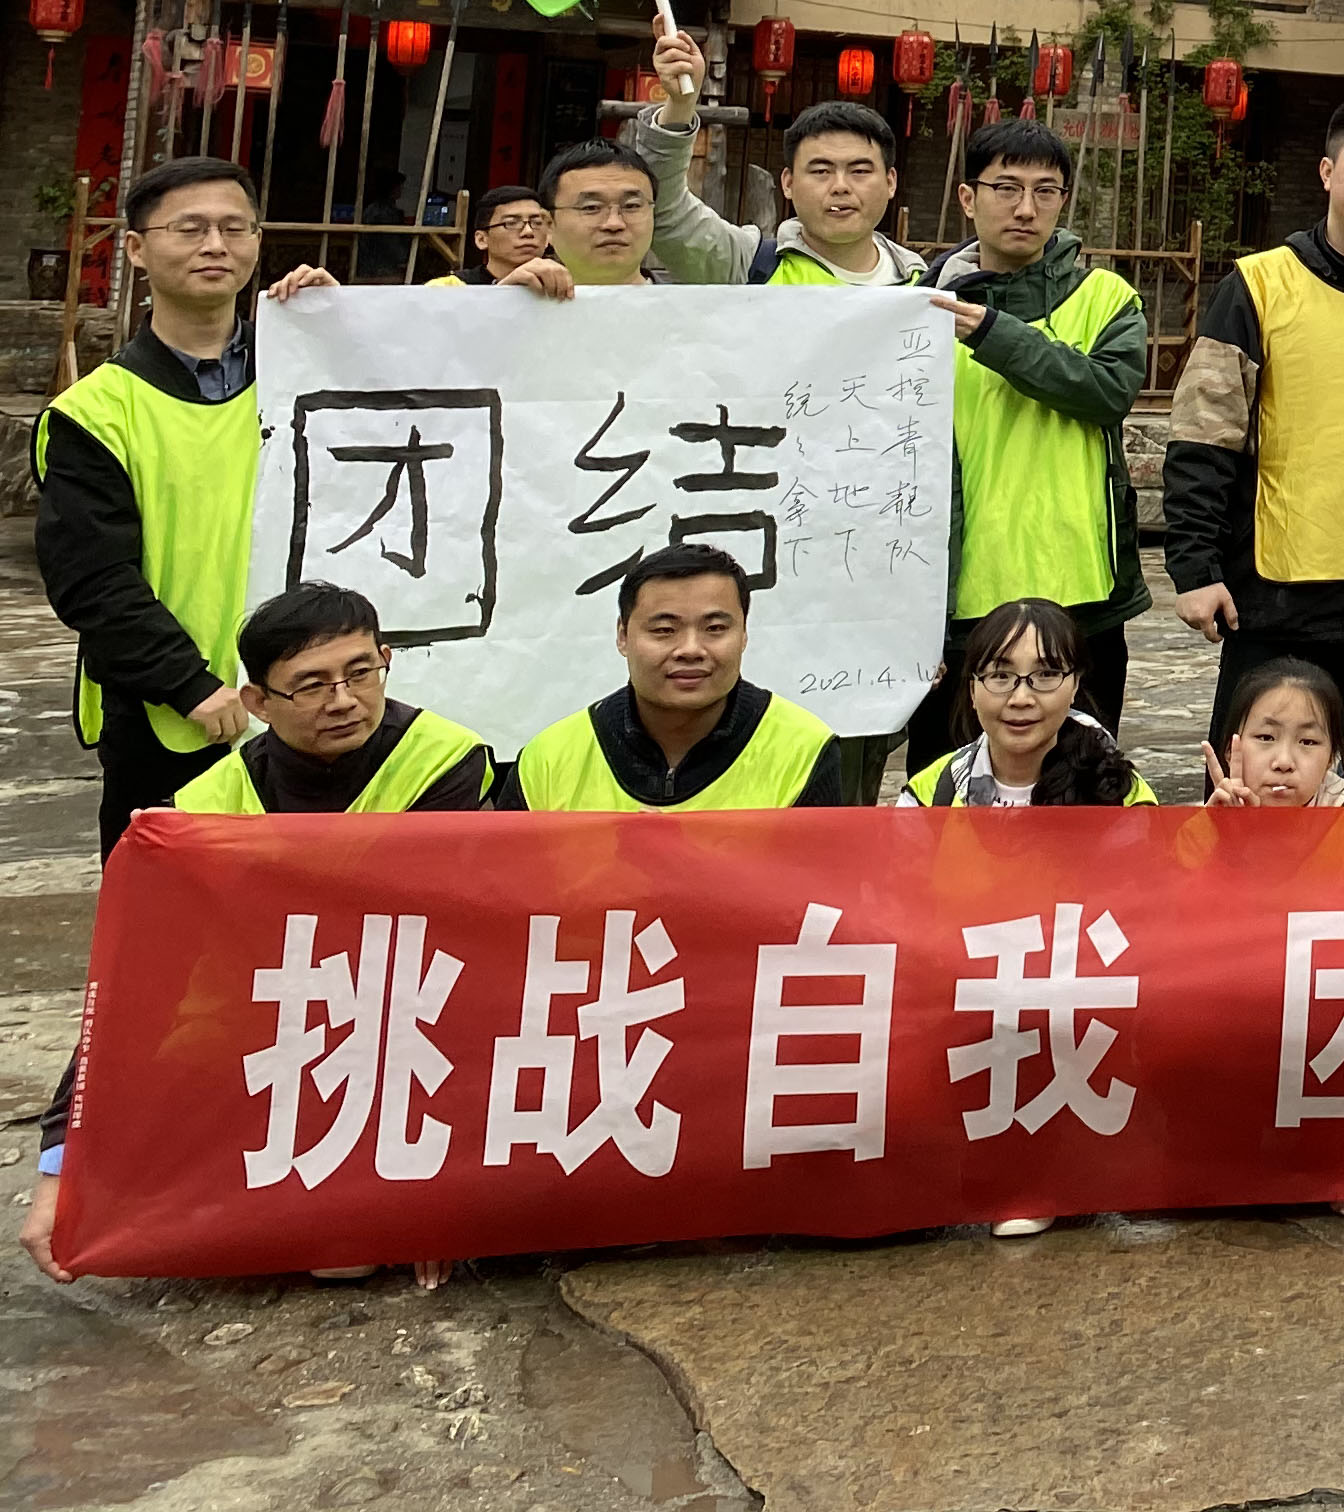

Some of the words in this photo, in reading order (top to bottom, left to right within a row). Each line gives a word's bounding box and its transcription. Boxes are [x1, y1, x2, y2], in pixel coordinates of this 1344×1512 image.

[285, 388, 788, 648] 团结
[827, 375, 880, 582] 天上地下
[243, 902, 1140, 1190] 挑战自我
